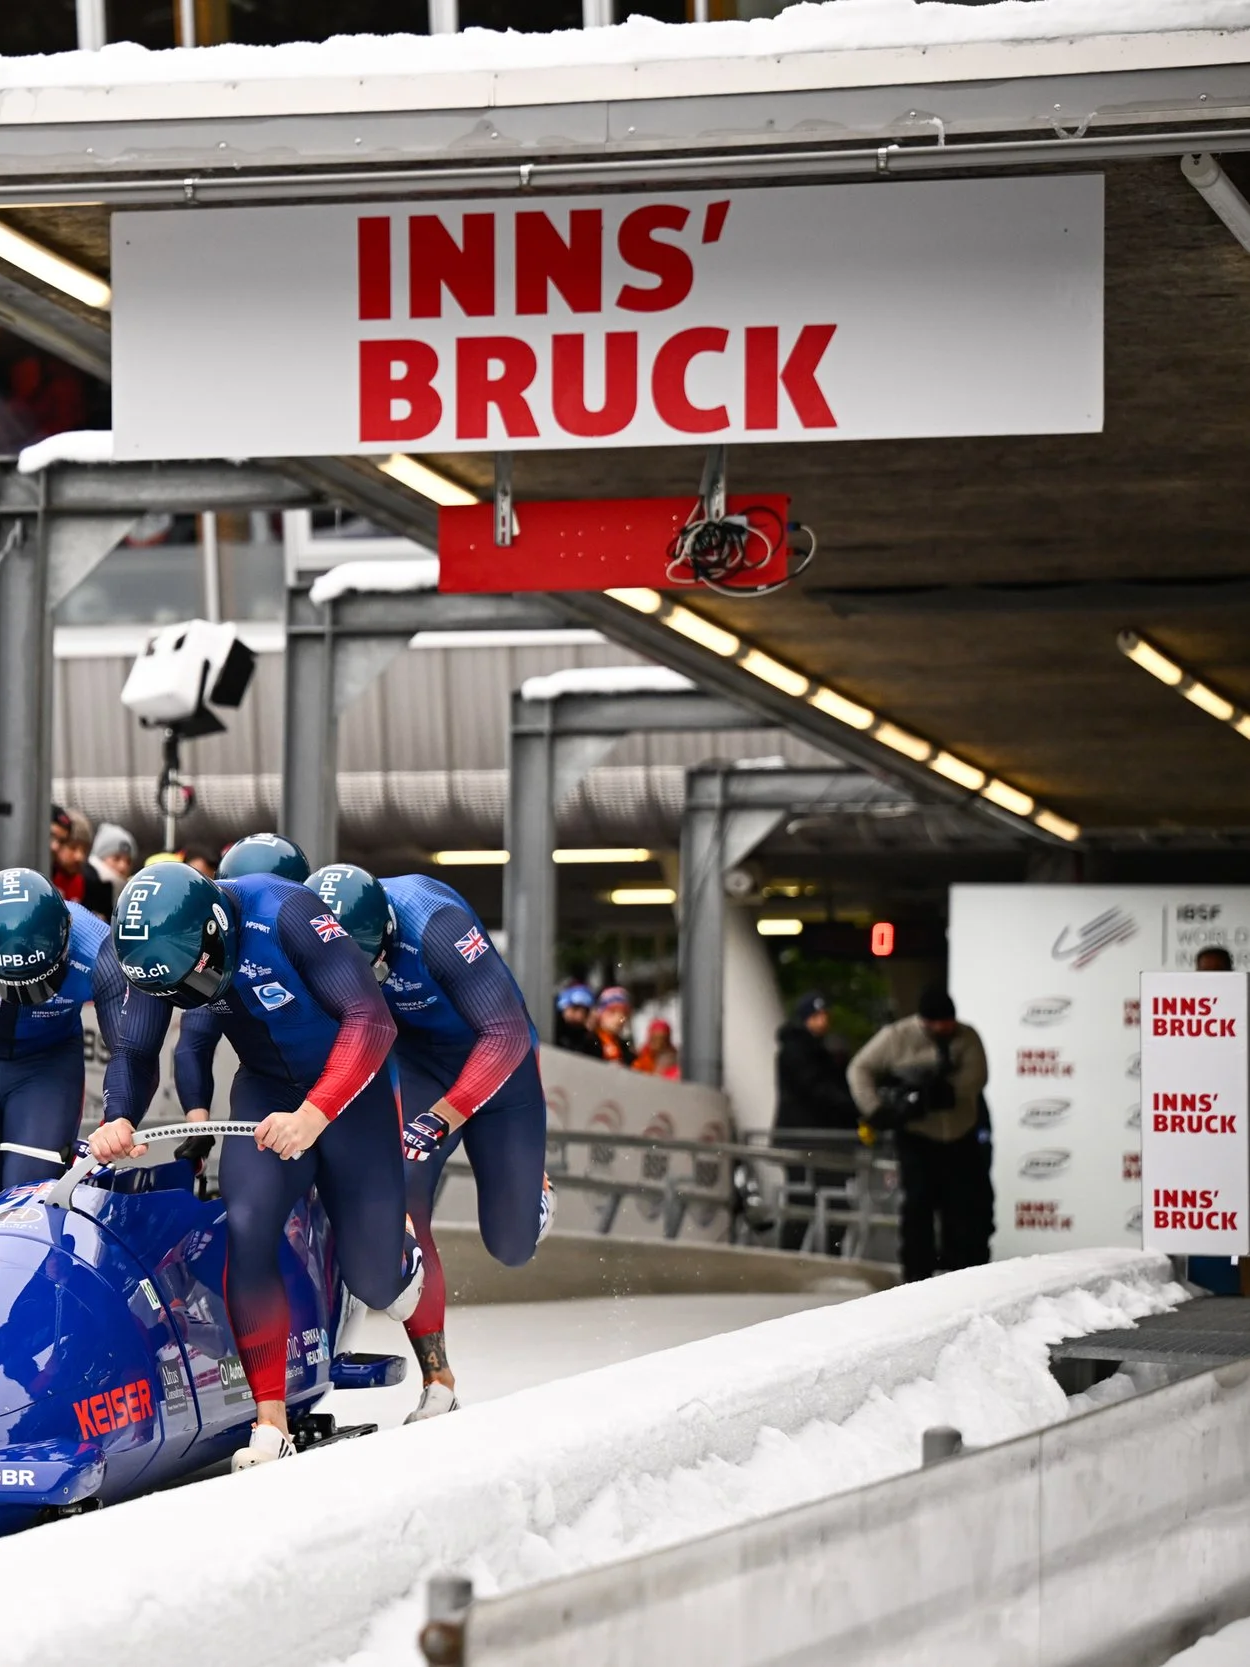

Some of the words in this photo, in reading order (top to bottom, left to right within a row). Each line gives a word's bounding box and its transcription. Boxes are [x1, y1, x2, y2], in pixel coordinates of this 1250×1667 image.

[358, 202, 730, 321] INNS'
[359, 324, 838, 443] BRUCK
[3, 870, 21, 895] HPB
[319, 872, 342, 904] HPB
[125, 889, 149, 930] HPB
[1152, 997, 1219, 1017] INNS'
[1152, 1018, 1237, 1038] BRUCK
[1153, 1093, 1220, 1113] INNS'
[1153, 1114, 1238, 1134] BRUCK
[402, 1130, 427, 1150] SEIZ
[1153, 1189, 1220, 1209] INNS'
[1153, 1210, 1239, 1231] BRUCK
[73, 1378, 154, 1440] KEISER
